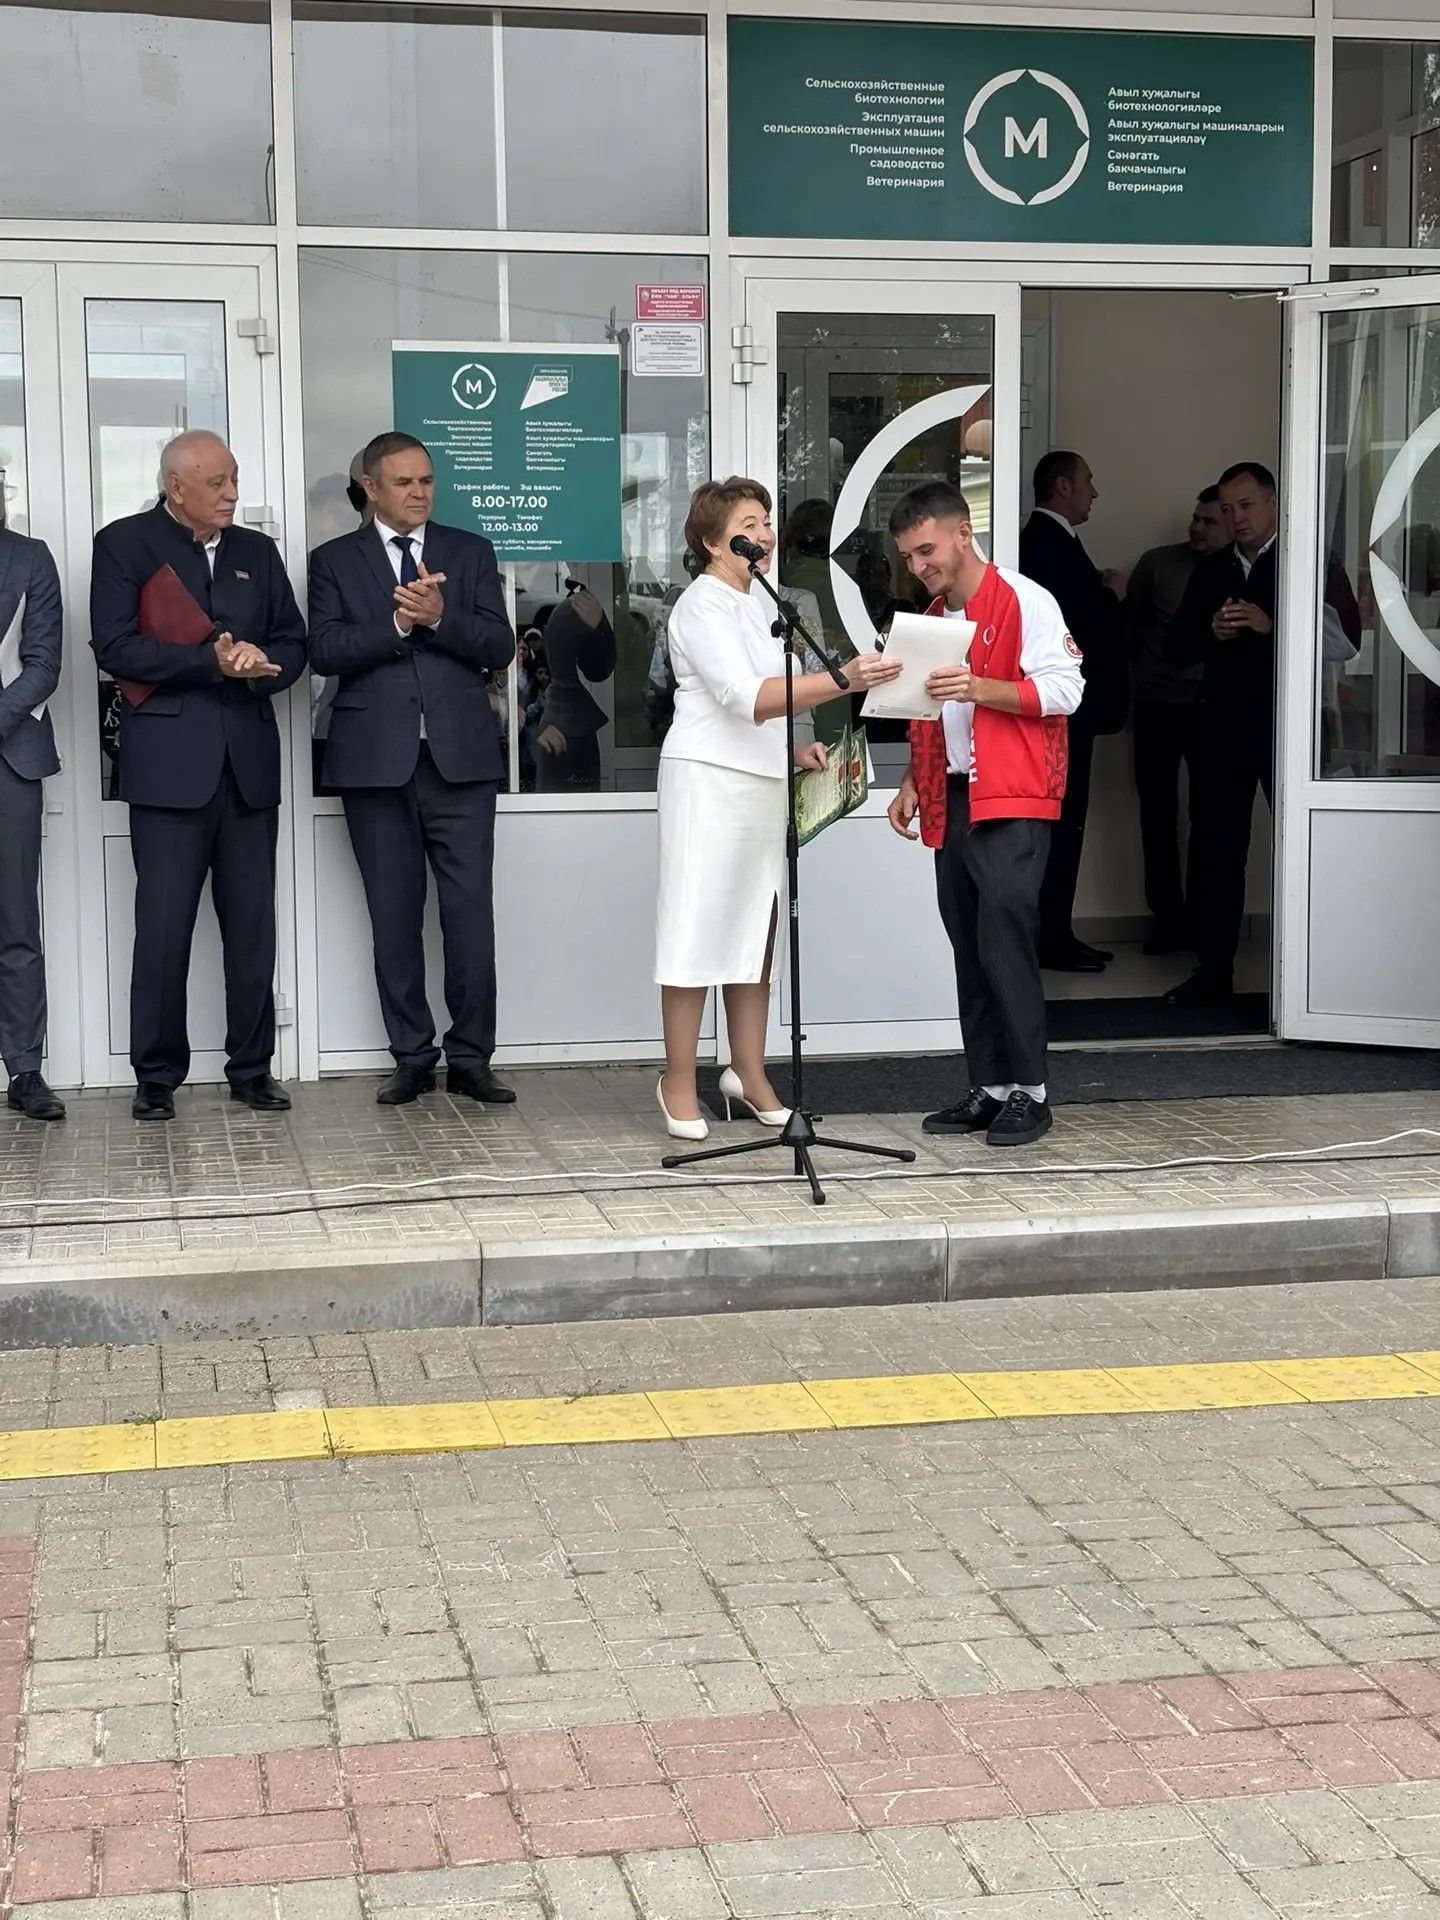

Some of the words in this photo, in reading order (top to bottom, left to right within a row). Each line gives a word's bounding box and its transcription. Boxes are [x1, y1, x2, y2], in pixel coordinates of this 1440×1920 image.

[805, 77, 945, 91] Сельскохозяйственные
[854, 93, 945, 105] биотехнологии
[1108, 87, 1139, 97] Авыл
[1142, 89, 1200, 100] хуҗалыгы
[1108, 101, 1222, 114] биотехнологияләре
[862, 112, 945, 124] Эксплуатация
[763, 124, 901, 137] сельскохозяйственных
[904, 129, 945, 138] машин
[1108, 118, 1139, 129] Авыл
[1141, 121, 1200, 131] хуҗалыгы
[1203, 123, 1285, 134] машиналарын
[1108, 133, 1207, 146] эксплуатацияләү
[850, 143, 945, 156] Промышленное
[1108, 150, 1160, 161] Сәнәгать
[870, 160, 945, 170] садоводство
[1108, 163, 1187, 175] бакчачылыгы
[867, 176, 945, 188] Ветеринария
[1108, 181, 1184, 194] Ветеринария
[453, 483, 481, 492] График
[482, 483, 510, 492] работы
[520, 484, 533, 492] Эш
[471, 495, 548, 509] 8.00-17.00
[482, 522, 538, 532] 12.00-13.00
